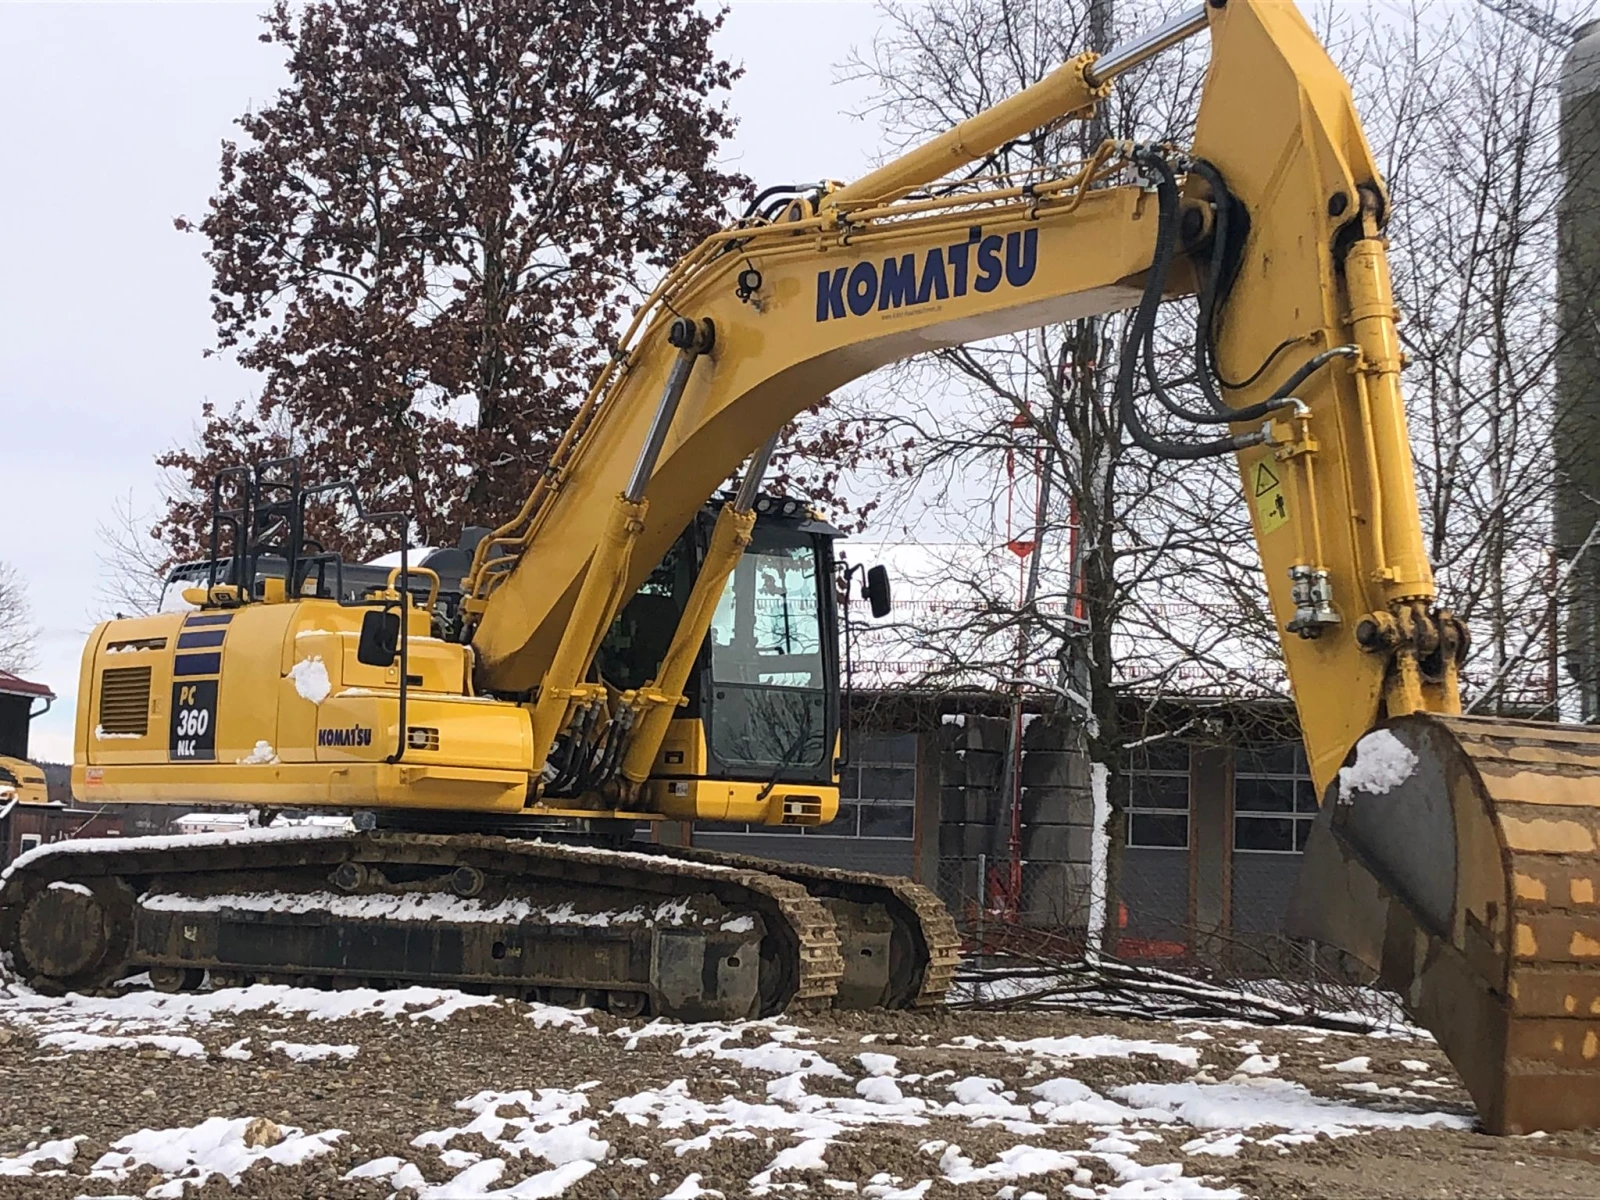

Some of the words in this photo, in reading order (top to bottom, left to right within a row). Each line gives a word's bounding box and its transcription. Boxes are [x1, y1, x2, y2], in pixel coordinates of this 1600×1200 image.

[816, 225, 1038, 322] KOMATSU
[179, 685, 196, 706] PC
[177, 709, 209, 736] 360
[318, 723, 372, 746] KOMATSU
[177, 740, 196, 756] NLC
